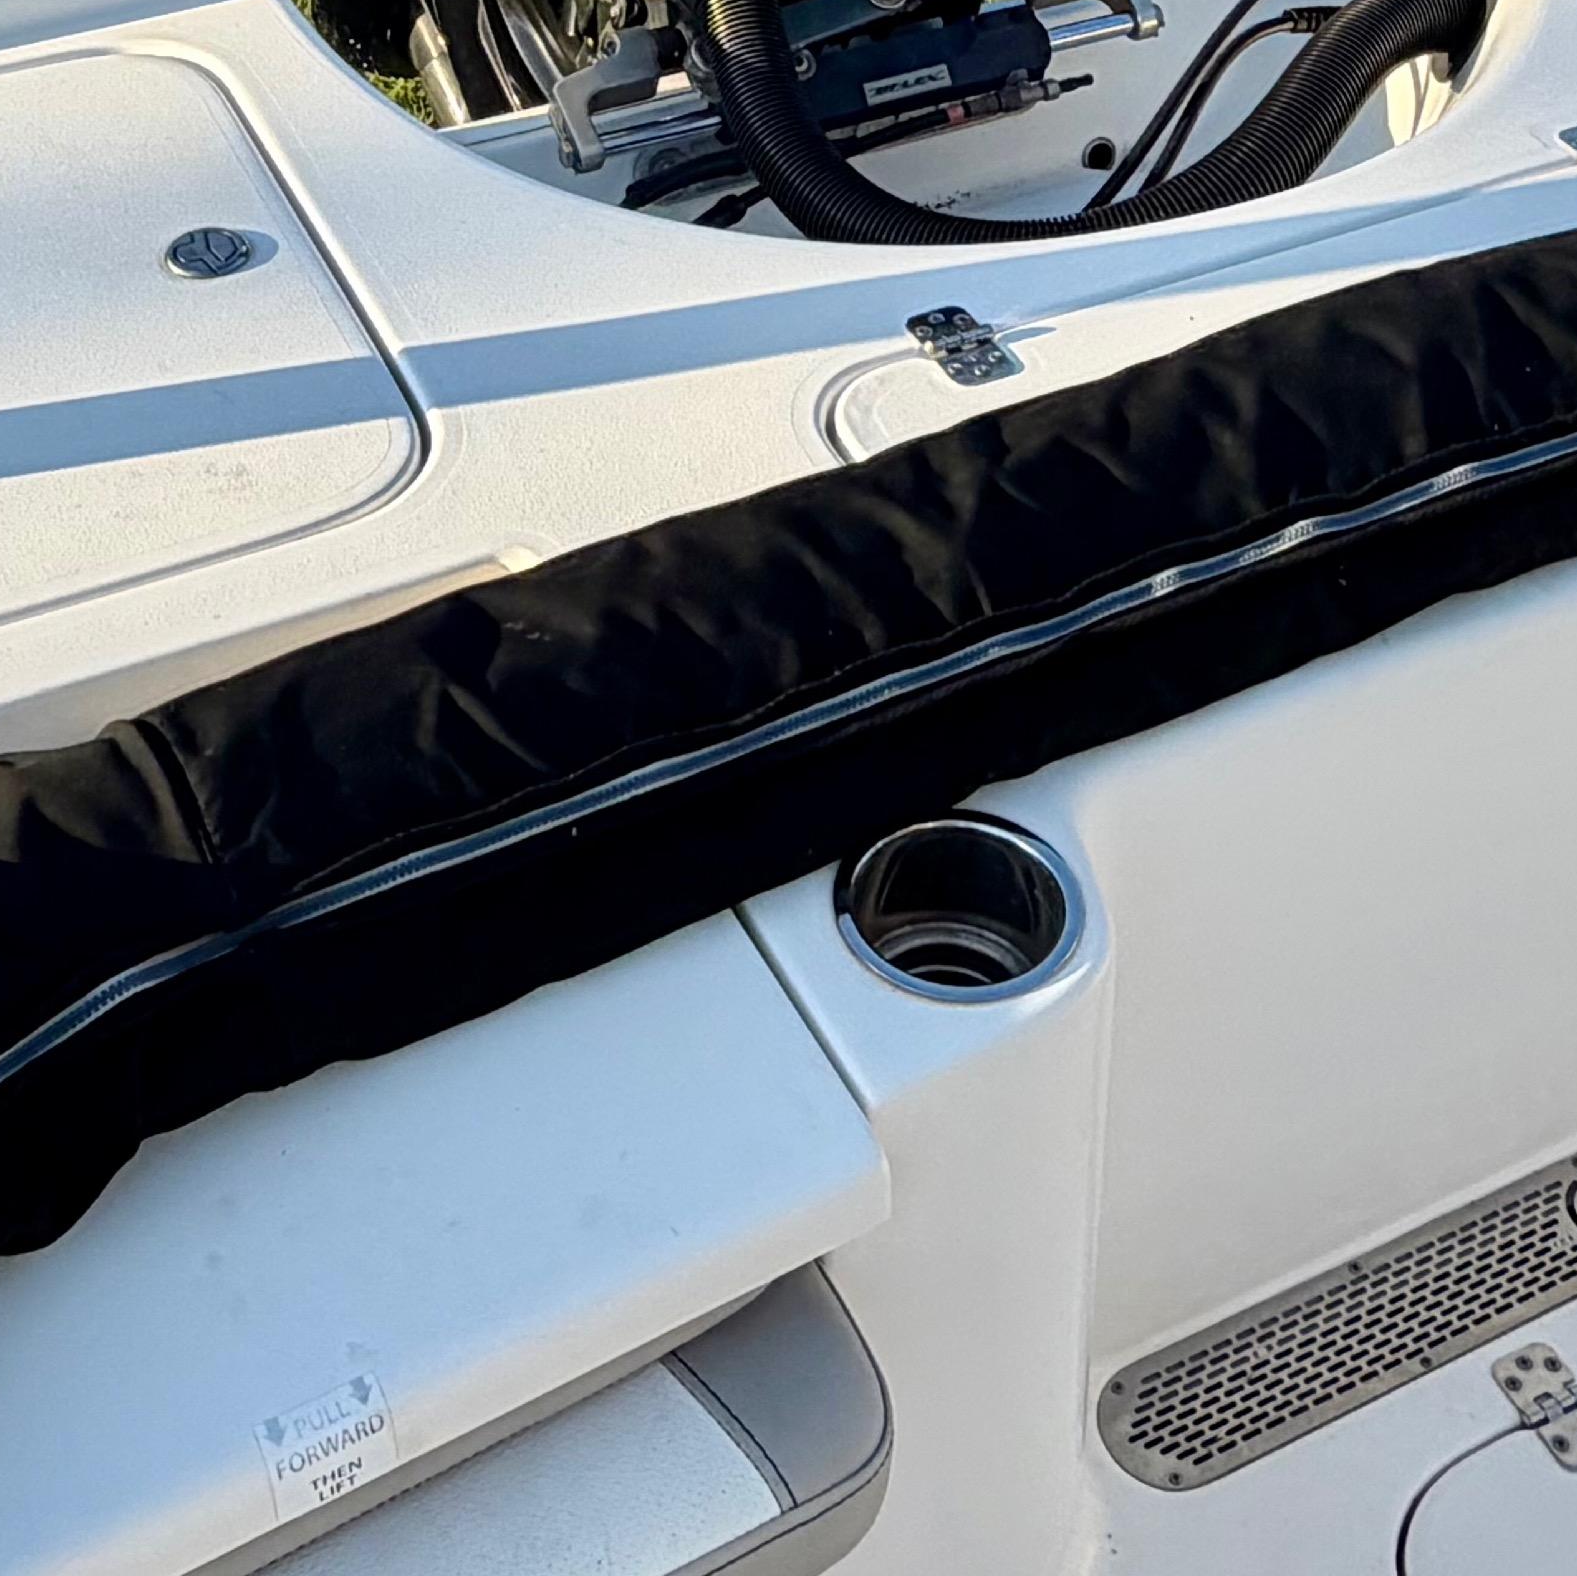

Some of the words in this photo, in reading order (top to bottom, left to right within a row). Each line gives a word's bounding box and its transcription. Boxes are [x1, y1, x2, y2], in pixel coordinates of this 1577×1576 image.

[293, 1401, 351, 1438] PULL
[276, 1414, 384, 1481] FORWARD
[309, 1456, 363, 1491] THEN
[319, 1474, 358, 1502] LIFT
